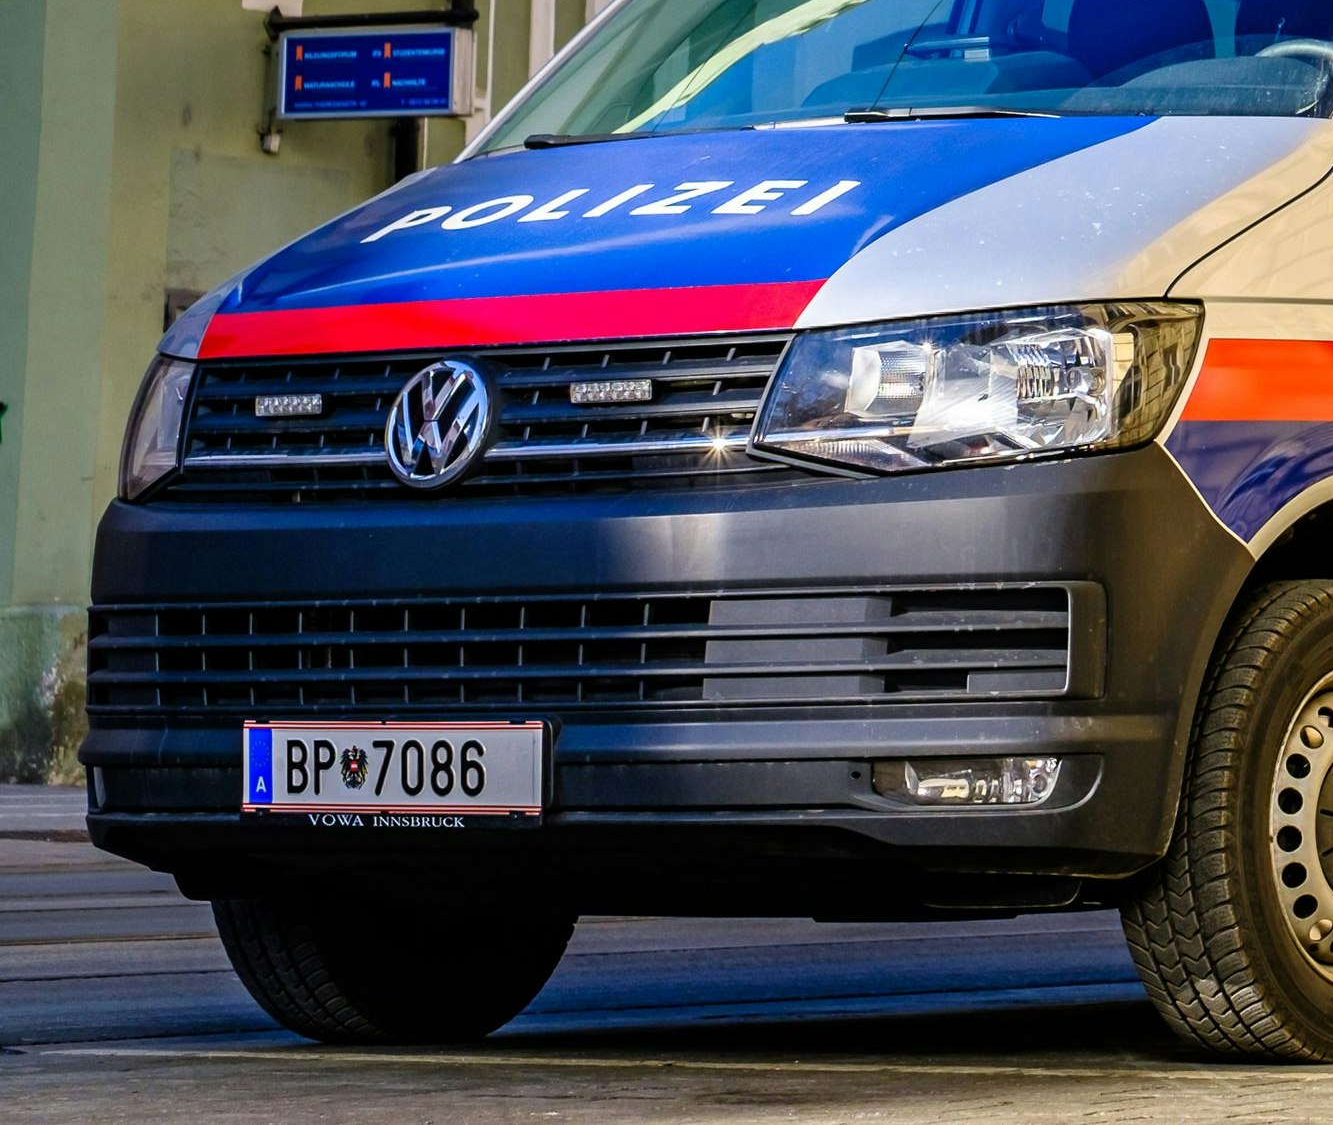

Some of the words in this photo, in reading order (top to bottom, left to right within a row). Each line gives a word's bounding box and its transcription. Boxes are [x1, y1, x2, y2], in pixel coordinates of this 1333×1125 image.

[360, 180, 861, 244] POLIZEI
[255, 776, 267, 793] A
[286, 739, 337, 795] BP
[372, 739, 486, 797] 7086
[308, 813, 365, 827] VOWA
[372, 815, 466, 828] INNSBRUCK
